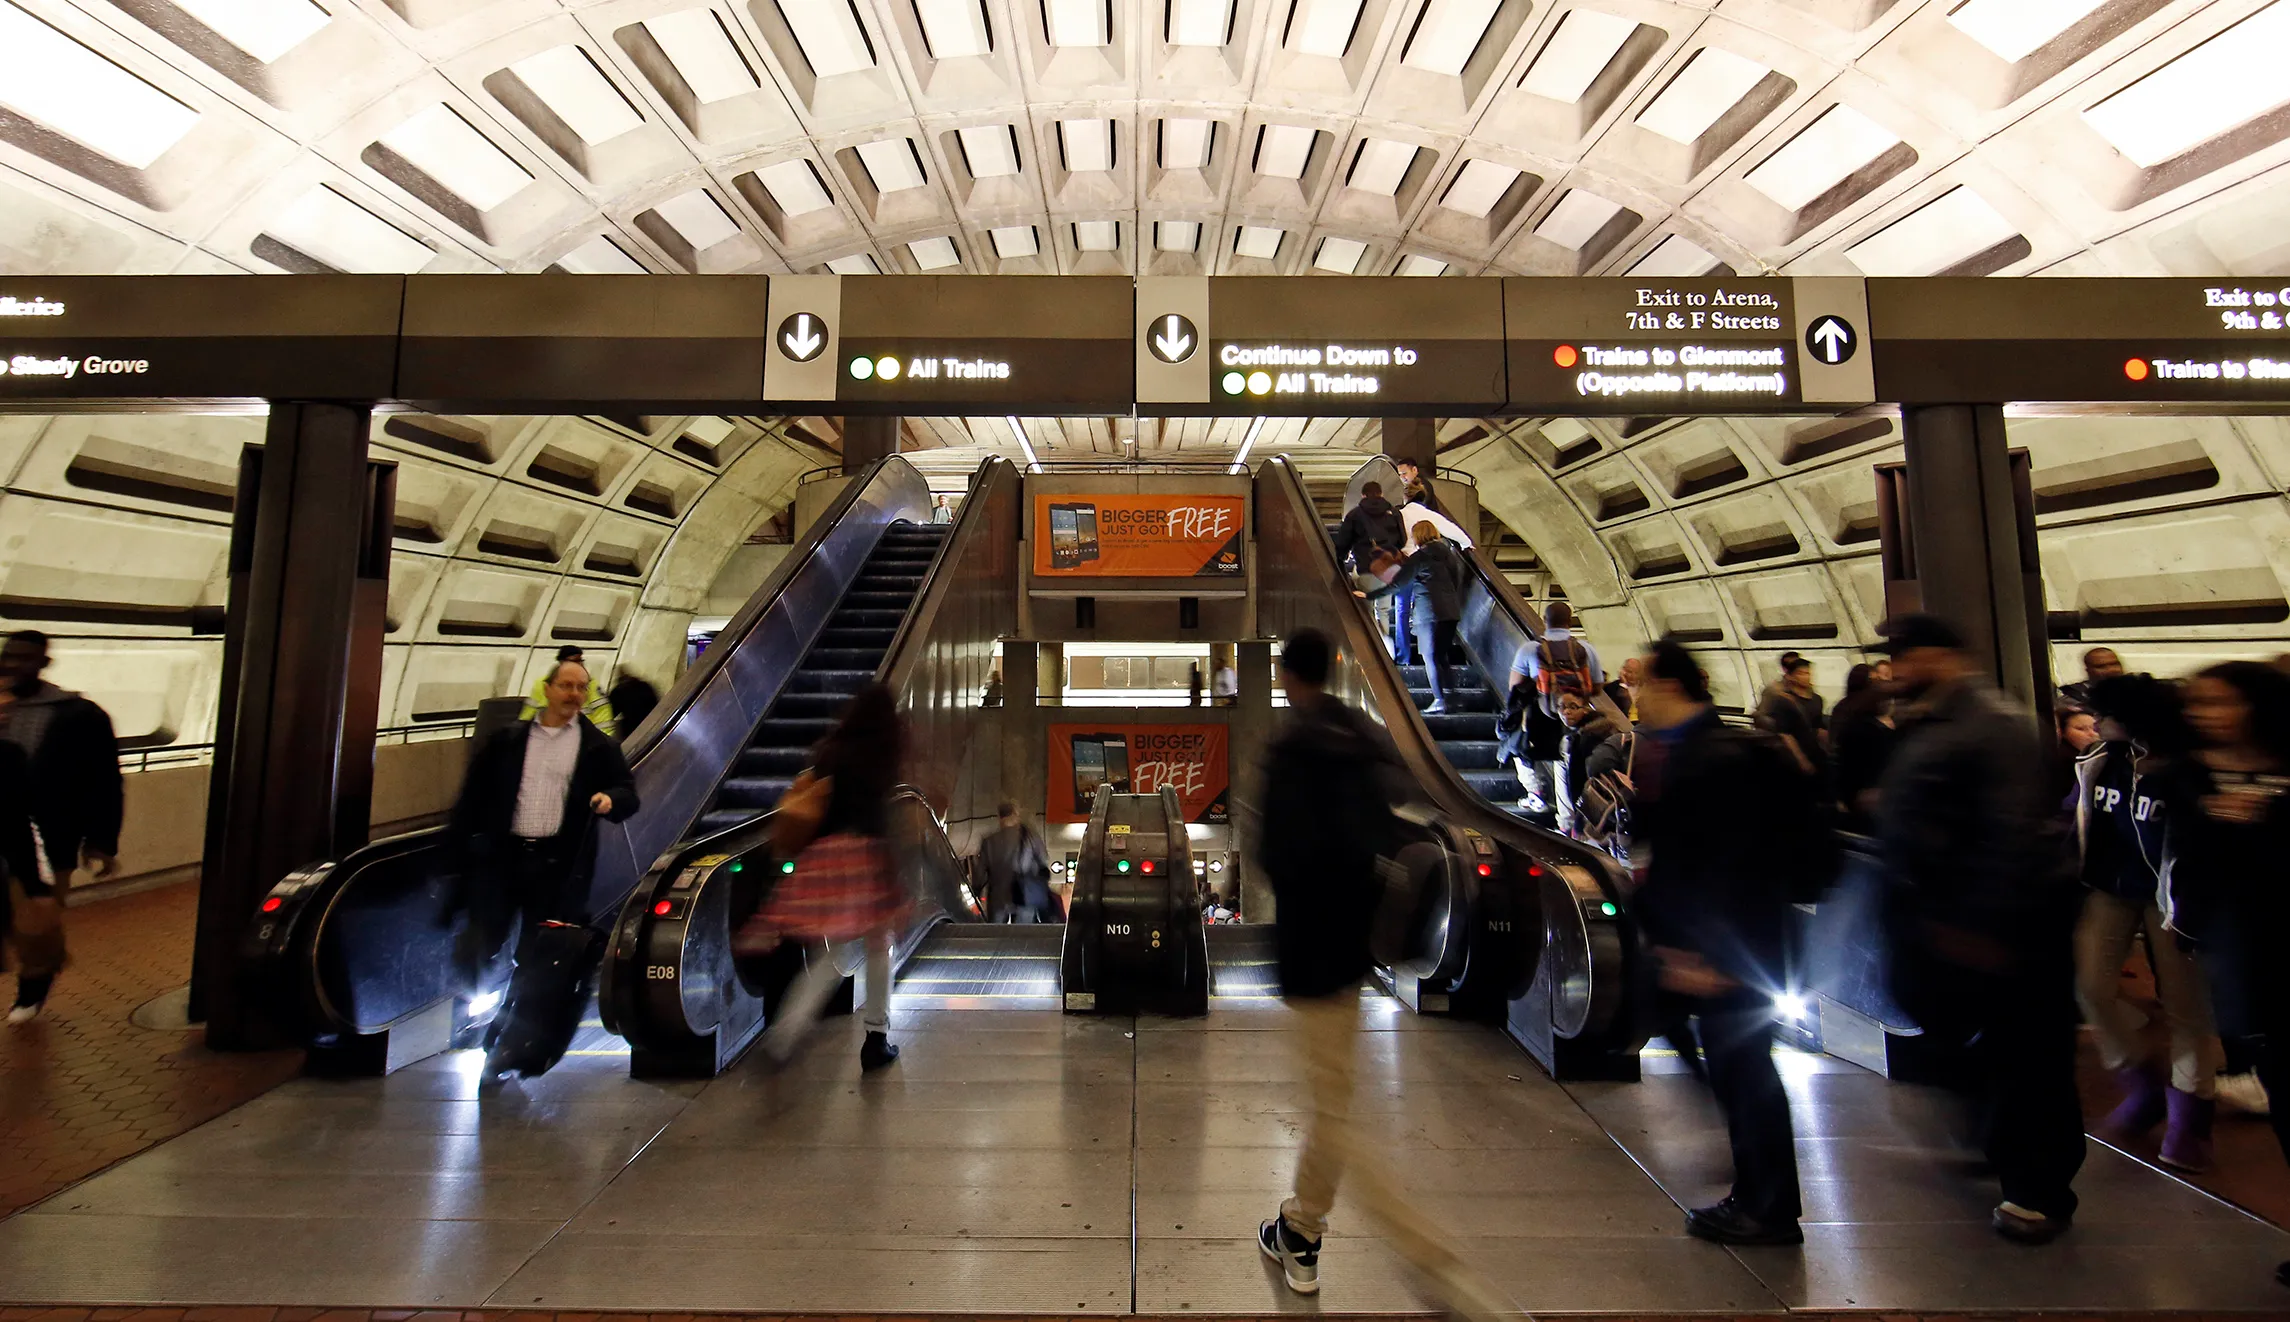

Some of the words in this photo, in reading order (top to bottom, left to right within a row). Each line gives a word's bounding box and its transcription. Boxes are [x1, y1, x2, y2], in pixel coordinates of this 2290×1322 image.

[1635, 288, 1681, 307] Exit
[1685, 290, 1707, 307] to
[1711, 288, 1780, 310] Arena,
[2203, 287, 2251, 307] Exit
[2253, 290, 2277, 307] to
[1626, 312, 1660, 330] 7th
[1665, 312, 1685, 330] &
[1690, 312, 1706, 329] F
[1711, 311, 1781, 330] Streets
[2221, 310, 2258, 330] 9th
[2260, 311, 2283, 330] &
[1220, 344, 1322, 366] Continue
[1326, 345, 1390, 366] Down
[1393, 346, 1418, 366] to
[1582, 346, 1648, 366] Trains
[1651, 347, 1676, 366] to
[1679, 345, 1784, 366] Glenmont
[10, 355, 80, 379] Shady
[83, 355, 149, 374] Grove
[907, 358, 938, 379] All
[942, 358, 1010, 379] Trains
[2151, 358, 2220, 379] Trains
[2221, 359, 2246, 379] to
[1275, 372, 1306, 394] All
[1310, 373, 1379, 394] Trains
[1576, 371, 1683, 396] (Opposite
[1686, 371, 1785, 396] Platform)
[1102, 509, 1167, 523] BIGGER
[1166, 506, 1231, 538] FREE
[1102, 525, 1135, 536] JUST
[1138, 525, 1168, 536] GOT
[1218, 562, 1239, 570] boost
[1134, 734, 1205, 750] BIGGER
[1135, 751, 1171, 763] JUST
[1175, 751, 1205, 763] GOT
[1134, 761, 1205, 796] FREE
[1106, 924, 1131, 935] N10
[1488, 920, 1512, 932] N11
[646, 965, 675, 980] E08
